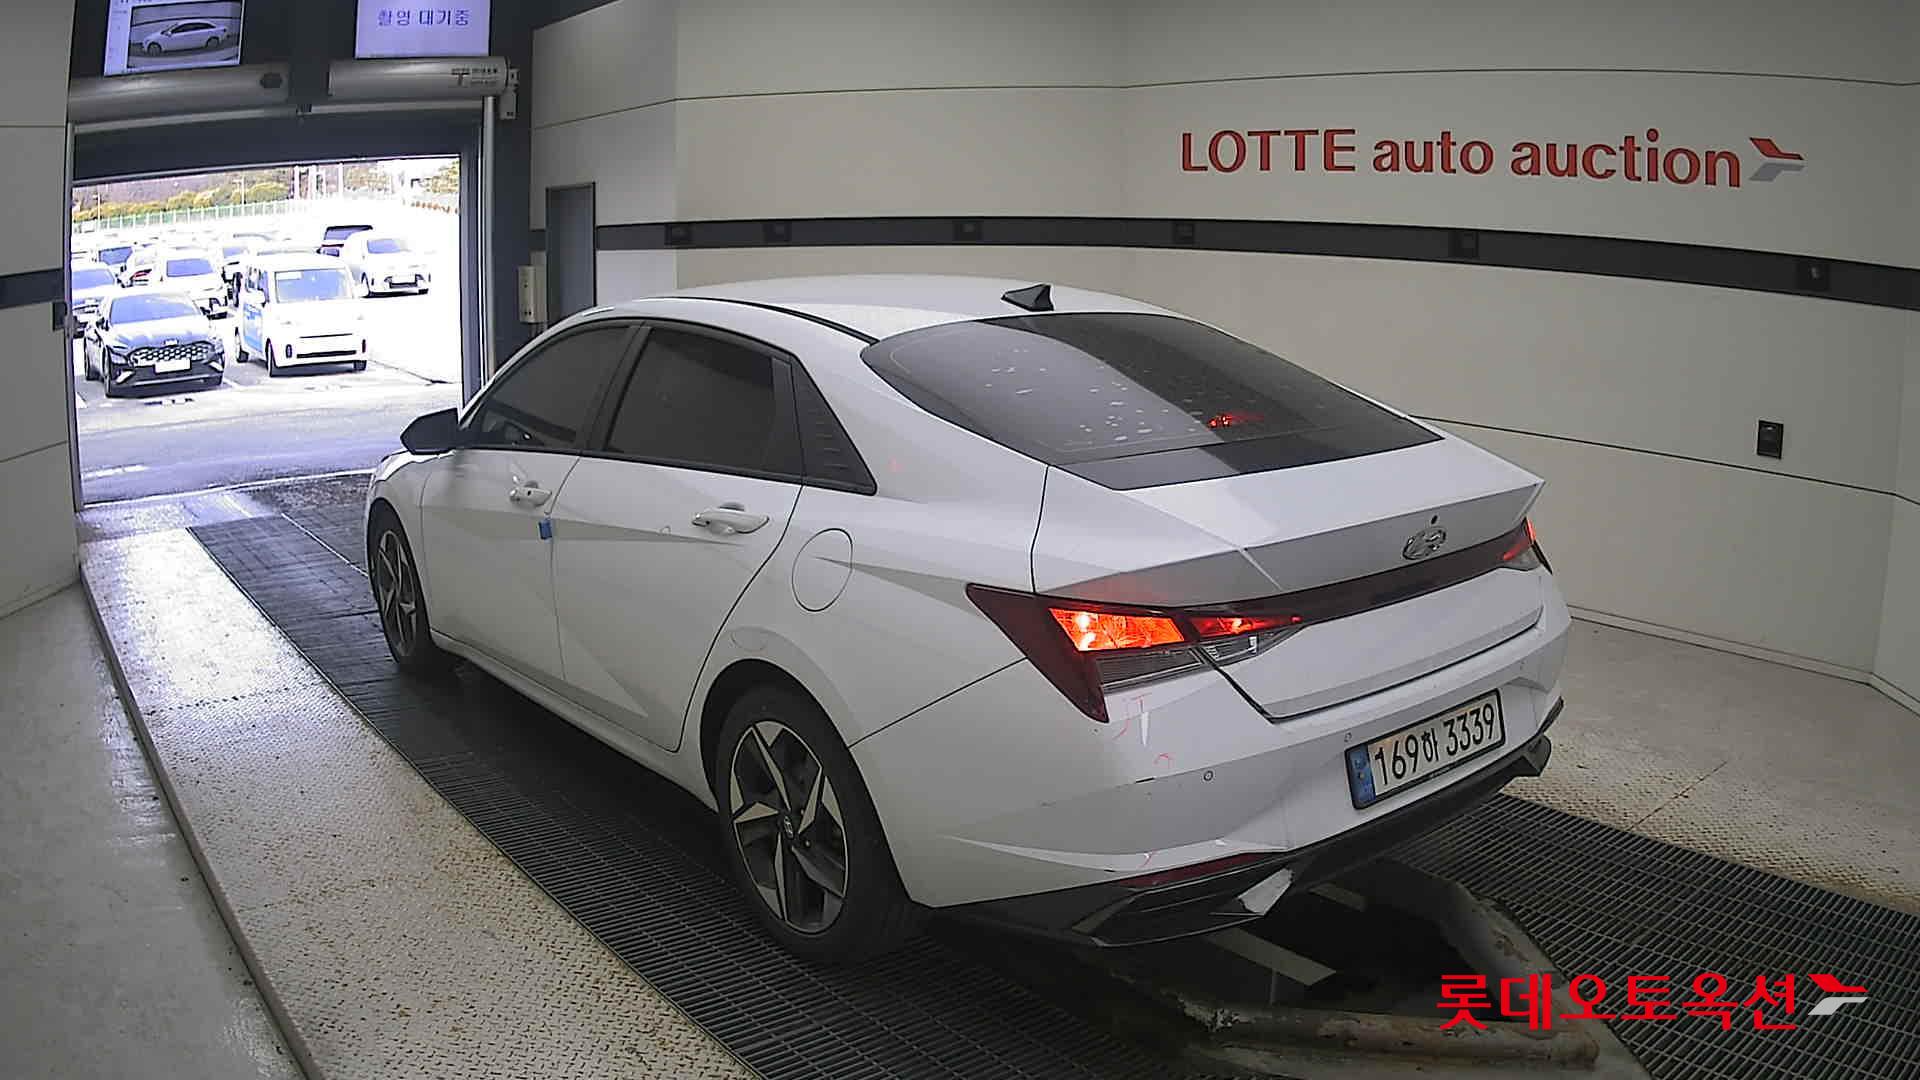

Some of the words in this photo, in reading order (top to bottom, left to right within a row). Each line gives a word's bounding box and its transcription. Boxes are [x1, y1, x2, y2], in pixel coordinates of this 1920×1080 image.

[419, 9, 469, 26] 대기중
[1181, 129, 1356, 173] LOTTE
[1372, 131, 1494, 174] auto
[1511, 128, 1741, 188] auction
[1374, 728, 1439, 785] 169하
[1443, 702, 1495, 756] 3339
